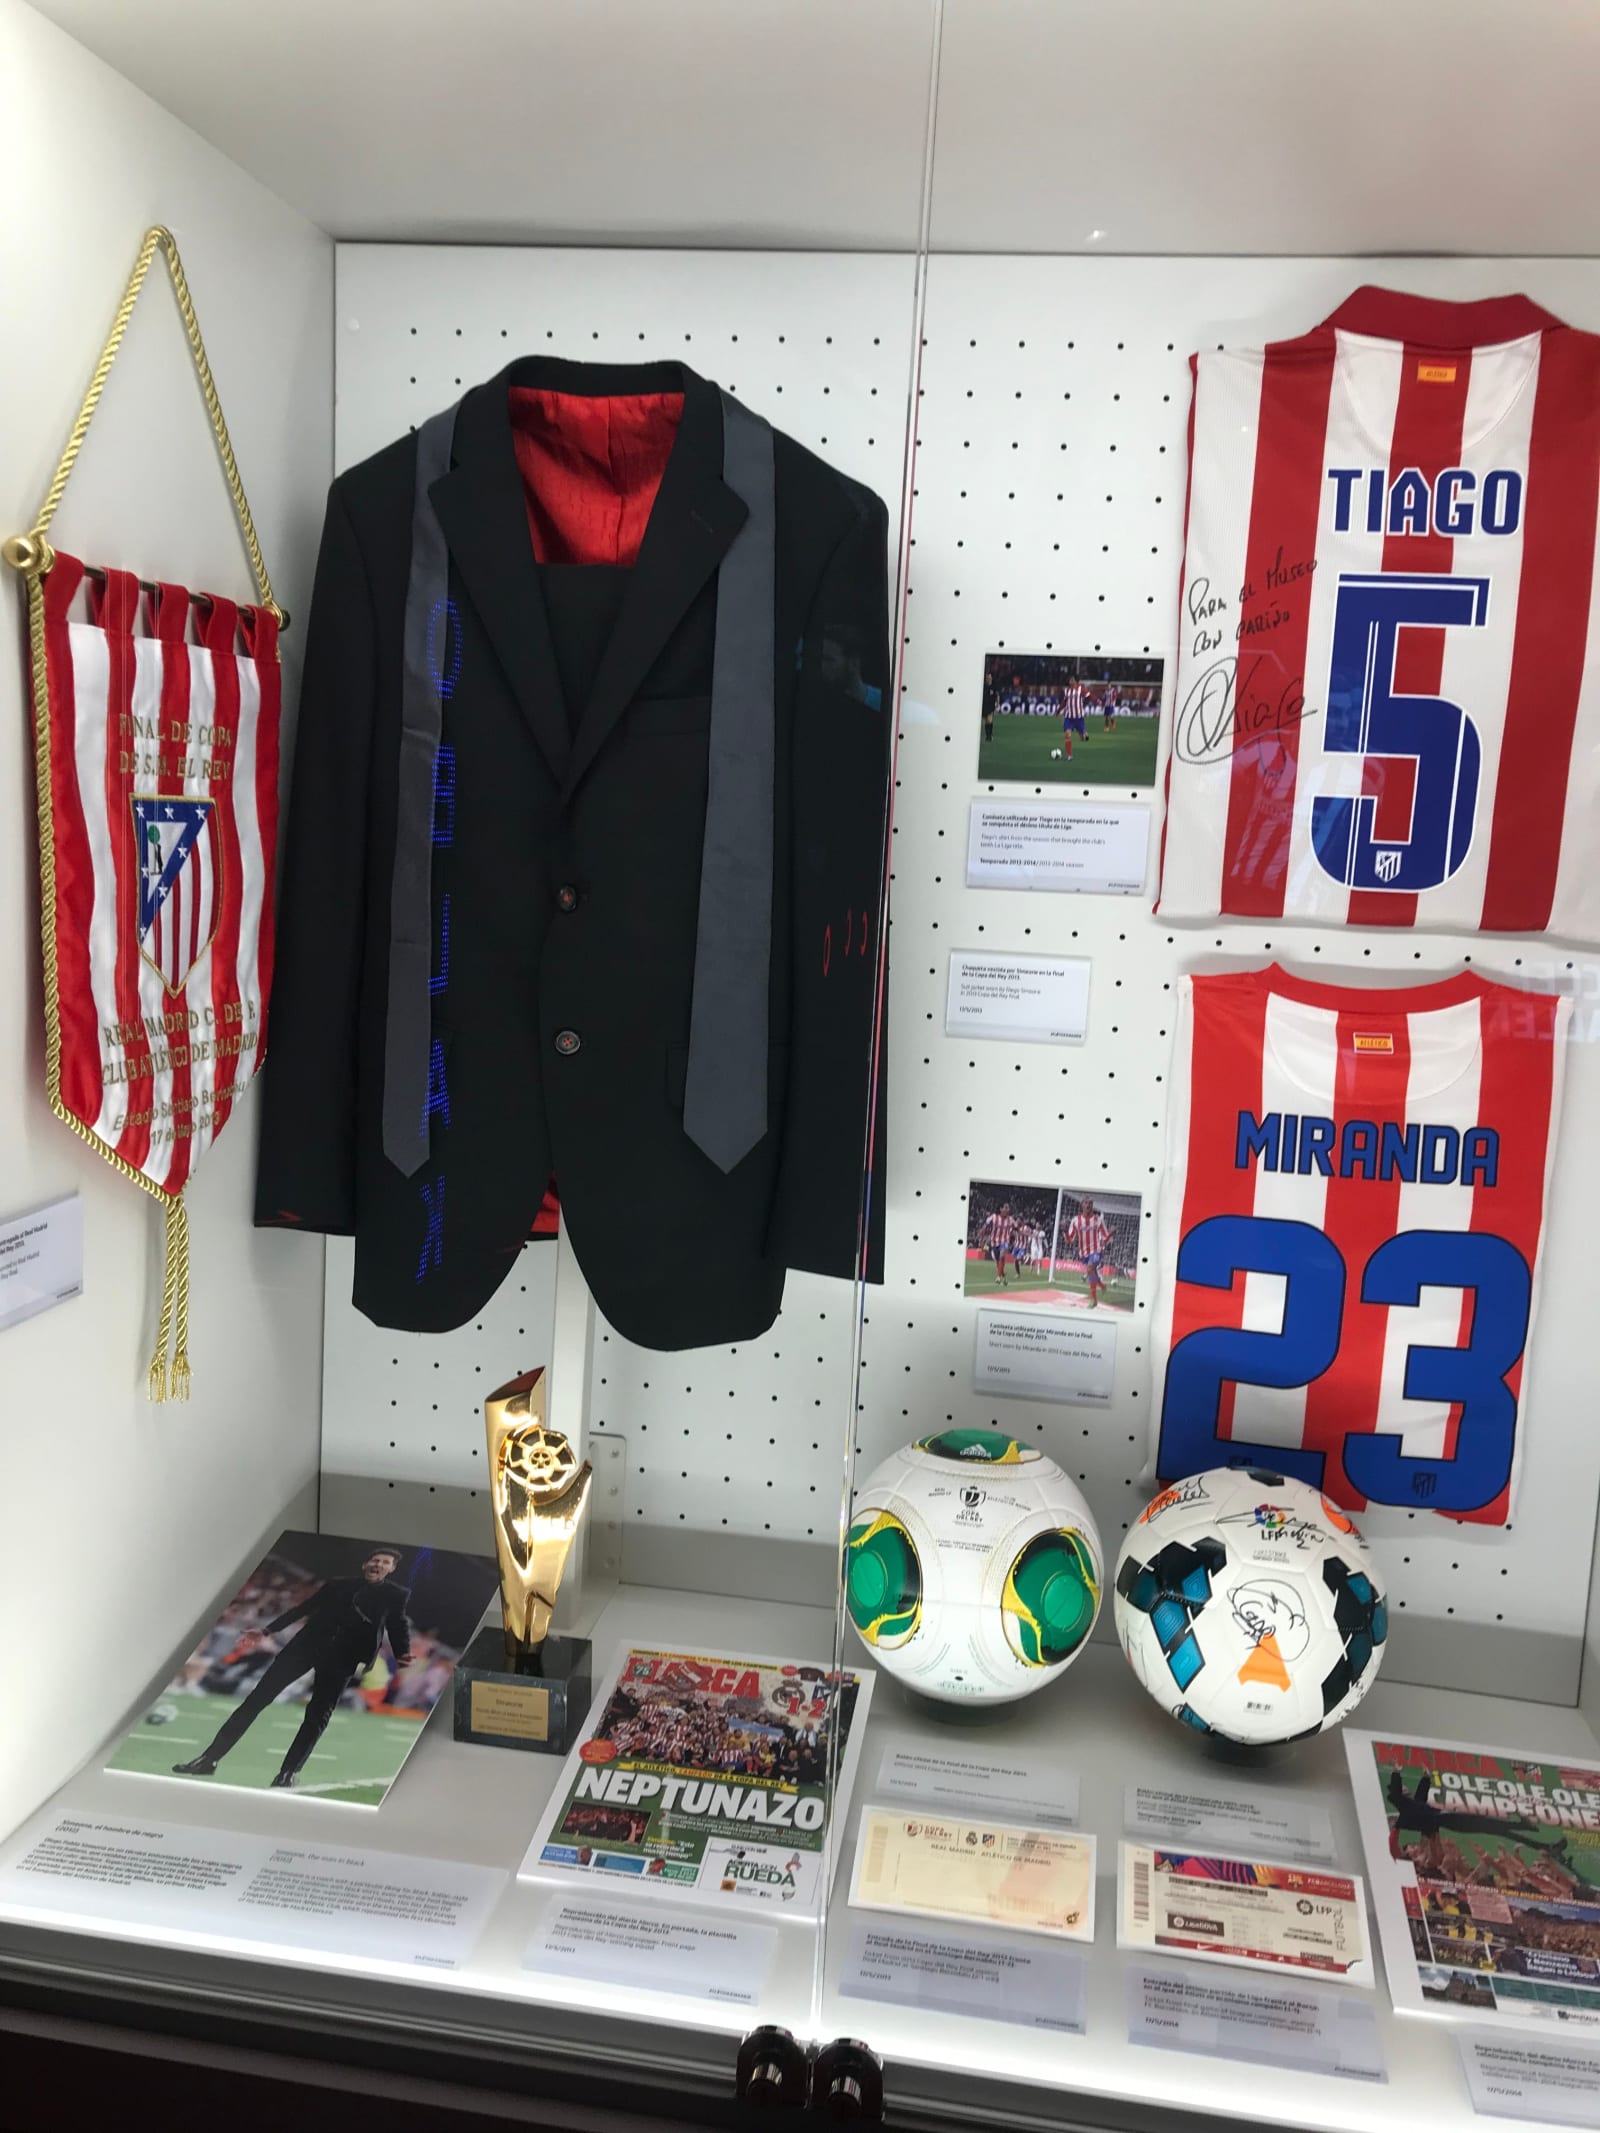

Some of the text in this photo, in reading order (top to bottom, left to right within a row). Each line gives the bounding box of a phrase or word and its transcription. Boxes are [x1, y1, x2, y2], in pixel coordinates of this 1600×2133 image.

[1327, 467, 1523, 536] TIAGO
[1189, 577, 1227, 626] PARA
[1238, 583, 1256, 603] EL
[120, 713, 231, 748] FINAL DE COPA
[1310, 572, 1491, 893] 5
[120, 750, 140, 774] DE
[177, 756, 196, 779] EL
[201, 758, 231, 781] REY
[104, 1020, 144, 1048] REAL
[224, 1001, 243, 1024] DE
[103, 1058, 137, 1086] CLUB
[192, 1041, 210, 1062] DE
[214, 1031, 259, 1058] MADRID
[152, 1128, 162, 1146] 17
[1234, 1109, 1501, 1188] MIRANDA
[1155, 1214, 1533, 1513] 23
[786, 1697, 828, 1719] 1-2
[1374, 1742, 1505, 1779] MARCA
[574, 1766, 826, 1832] NEPTUNAZO
[723, 1864, 796, 1888] RUEDA
